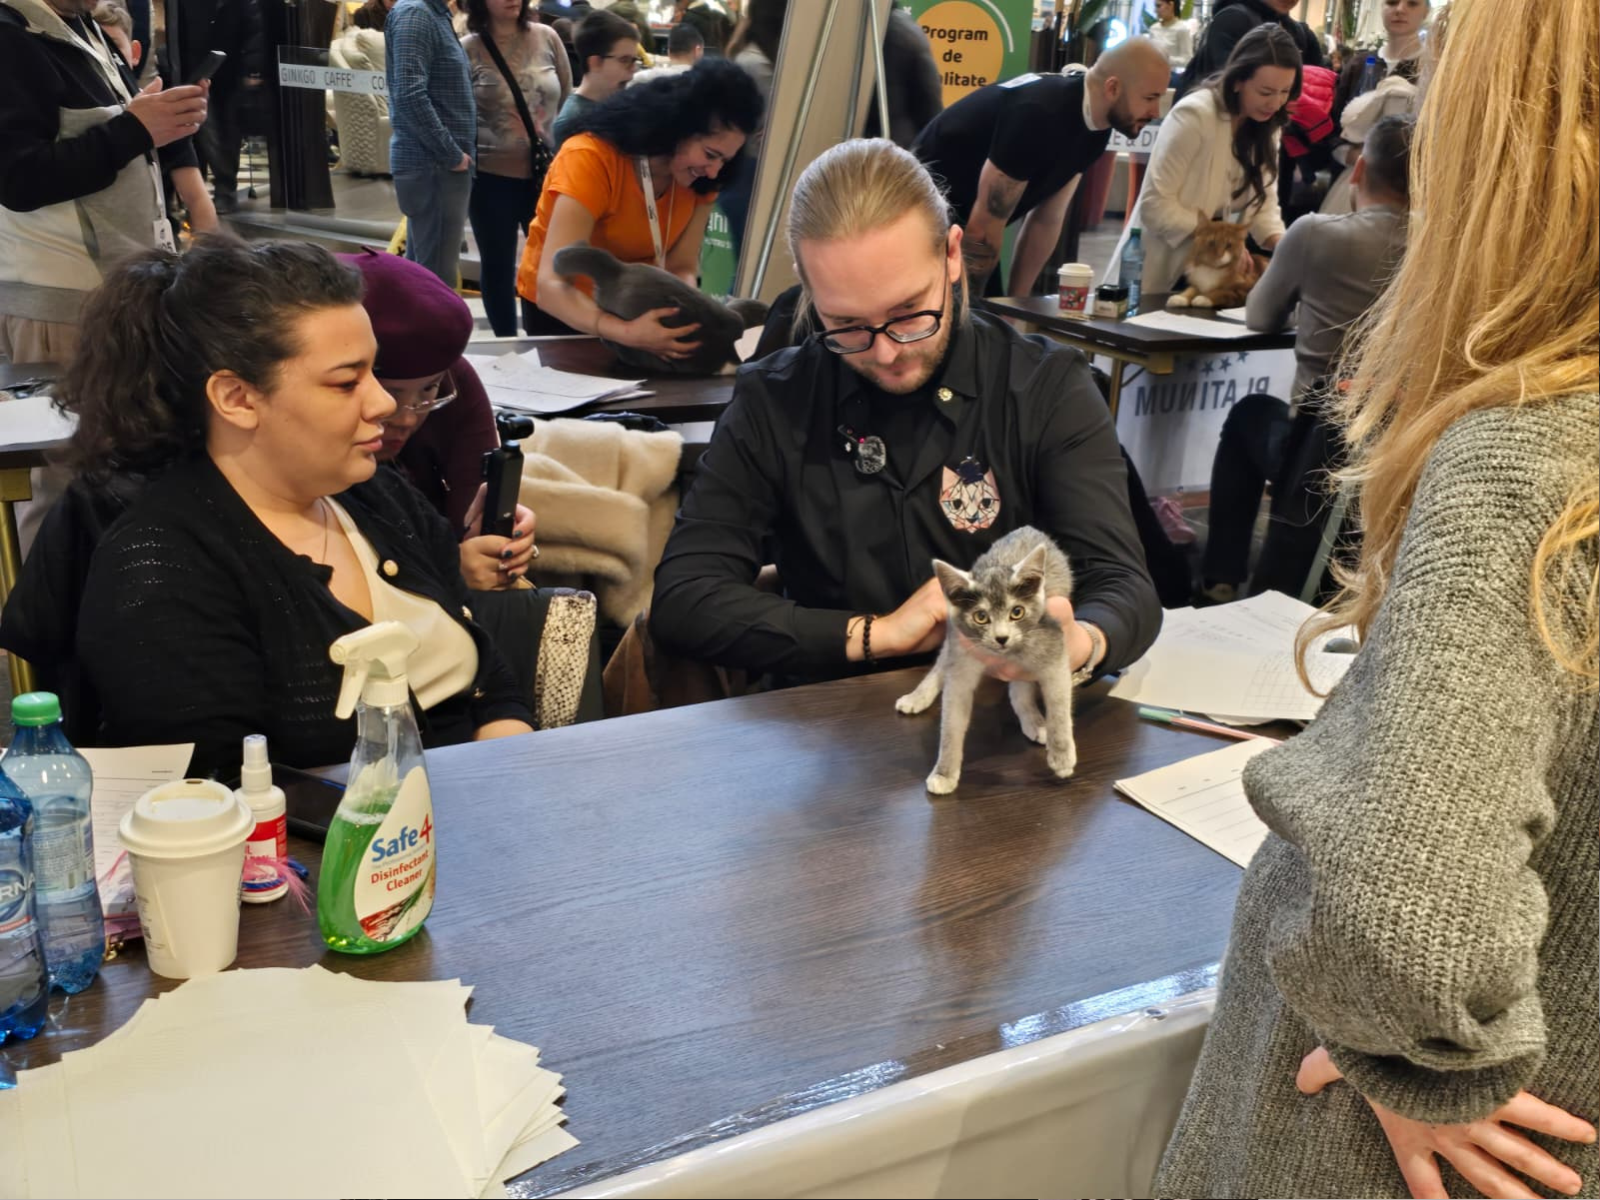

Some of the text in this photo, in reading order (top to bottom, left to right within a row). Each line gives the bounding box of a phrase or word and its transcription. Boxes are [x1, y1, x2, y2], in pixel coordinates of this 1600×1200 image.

[921, 25, 988, 43] Program
[942, 49, 963, 63] de
[281, 67, 316, 85] GINKGO
[940, 71, 987, 87] litate
[370, 850, 429, 885] Disinfectant
[386, 869, 423, 892] Cleaner
